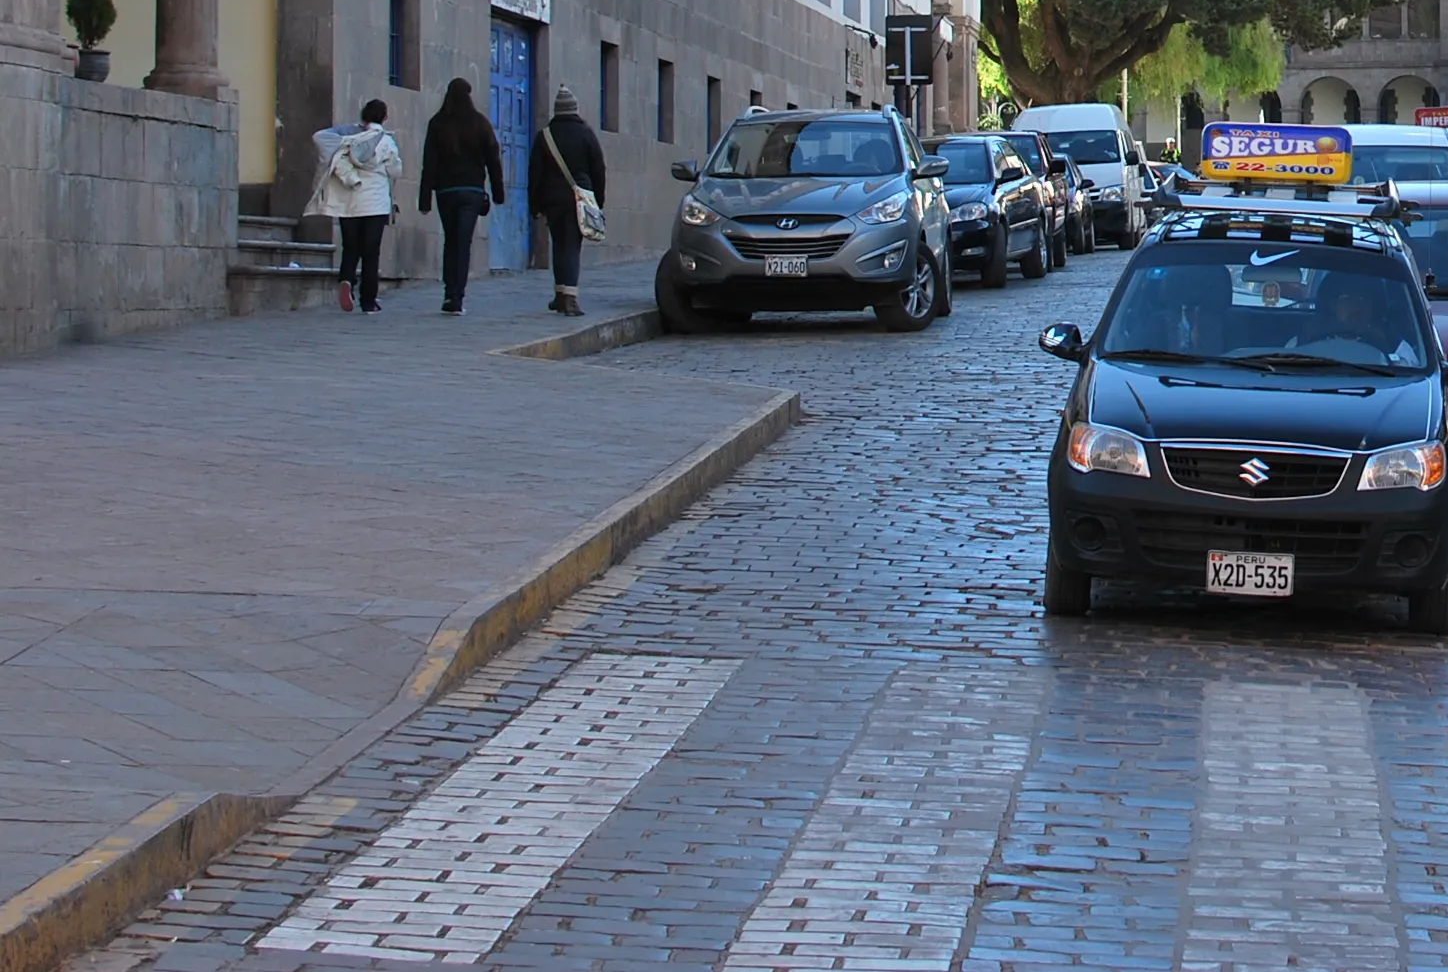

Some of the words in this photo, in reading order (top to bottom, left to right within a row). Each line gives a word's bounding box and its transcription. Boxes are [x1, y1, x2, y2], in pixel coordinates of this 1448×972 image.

[1228, 129, 1280, 139] TAXI
[1235, 162, 1336, 176] 22-3000
[1236, 555, 1266, 564] PERU
[1211, 562, 1289, 590] X2D-535
